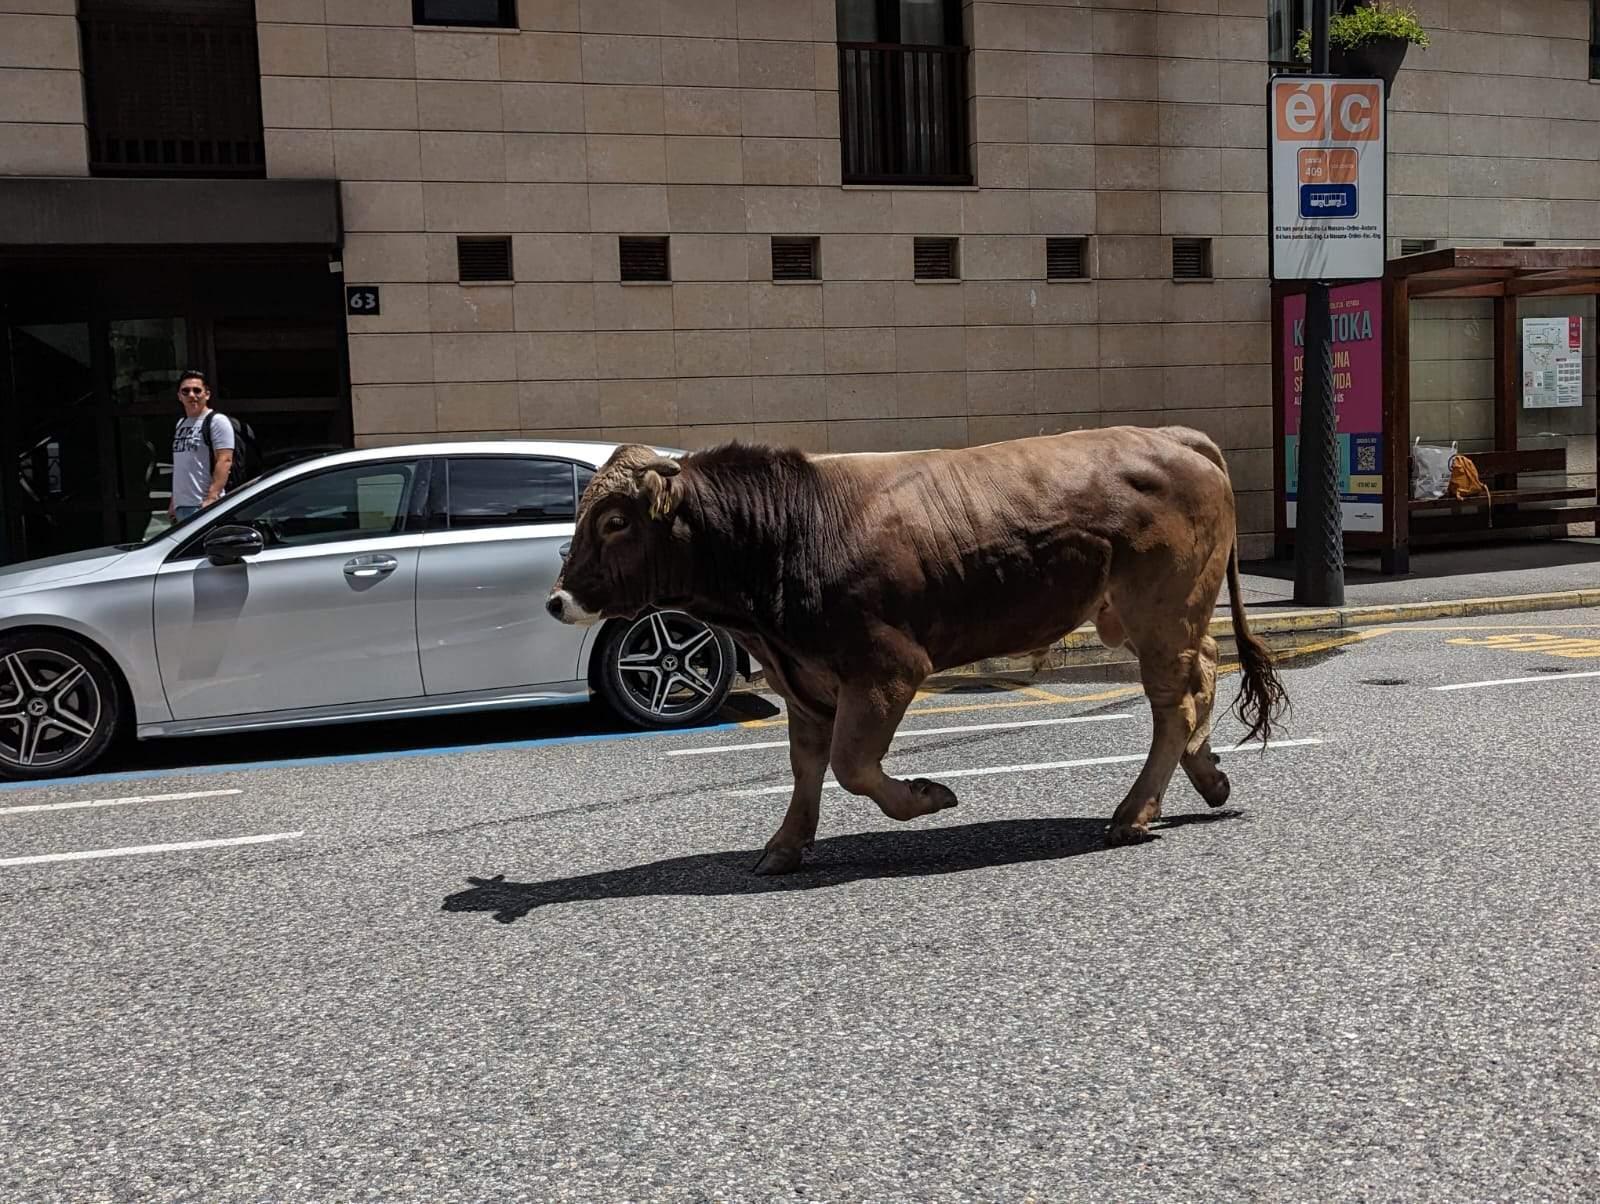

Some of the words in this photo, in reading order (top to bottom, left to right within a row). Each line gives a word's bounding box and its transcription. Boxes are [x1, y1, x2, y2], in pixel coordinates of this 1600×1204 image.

[1285, 83, 1316, 133] é
[1304, 167, 1322, 176] 409
[350, 292, 376, 309] 63
